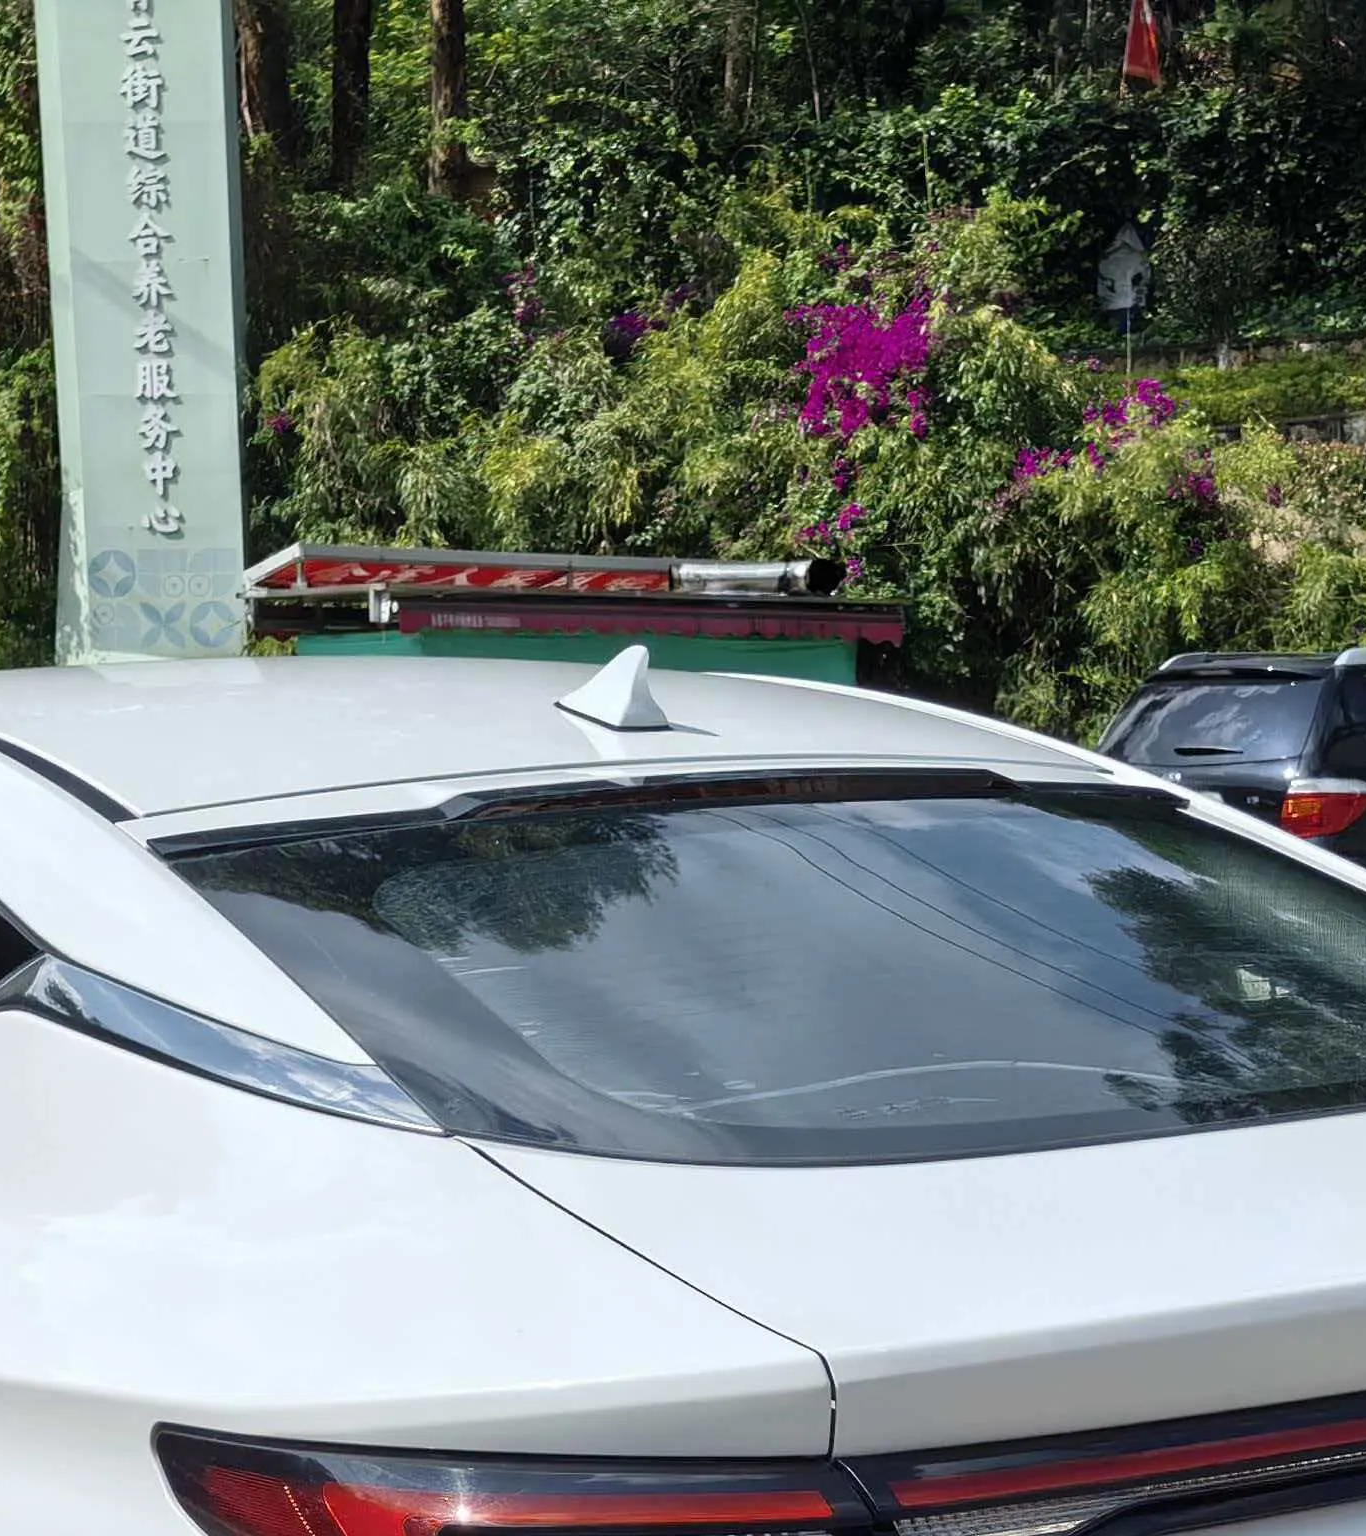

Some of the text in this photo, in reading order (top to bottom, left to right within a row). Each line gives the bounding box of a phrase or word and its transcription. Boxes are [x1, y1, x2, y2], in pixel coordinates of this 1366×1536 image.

[119, 0, 183, 537] 云街道综合养老服务中心
